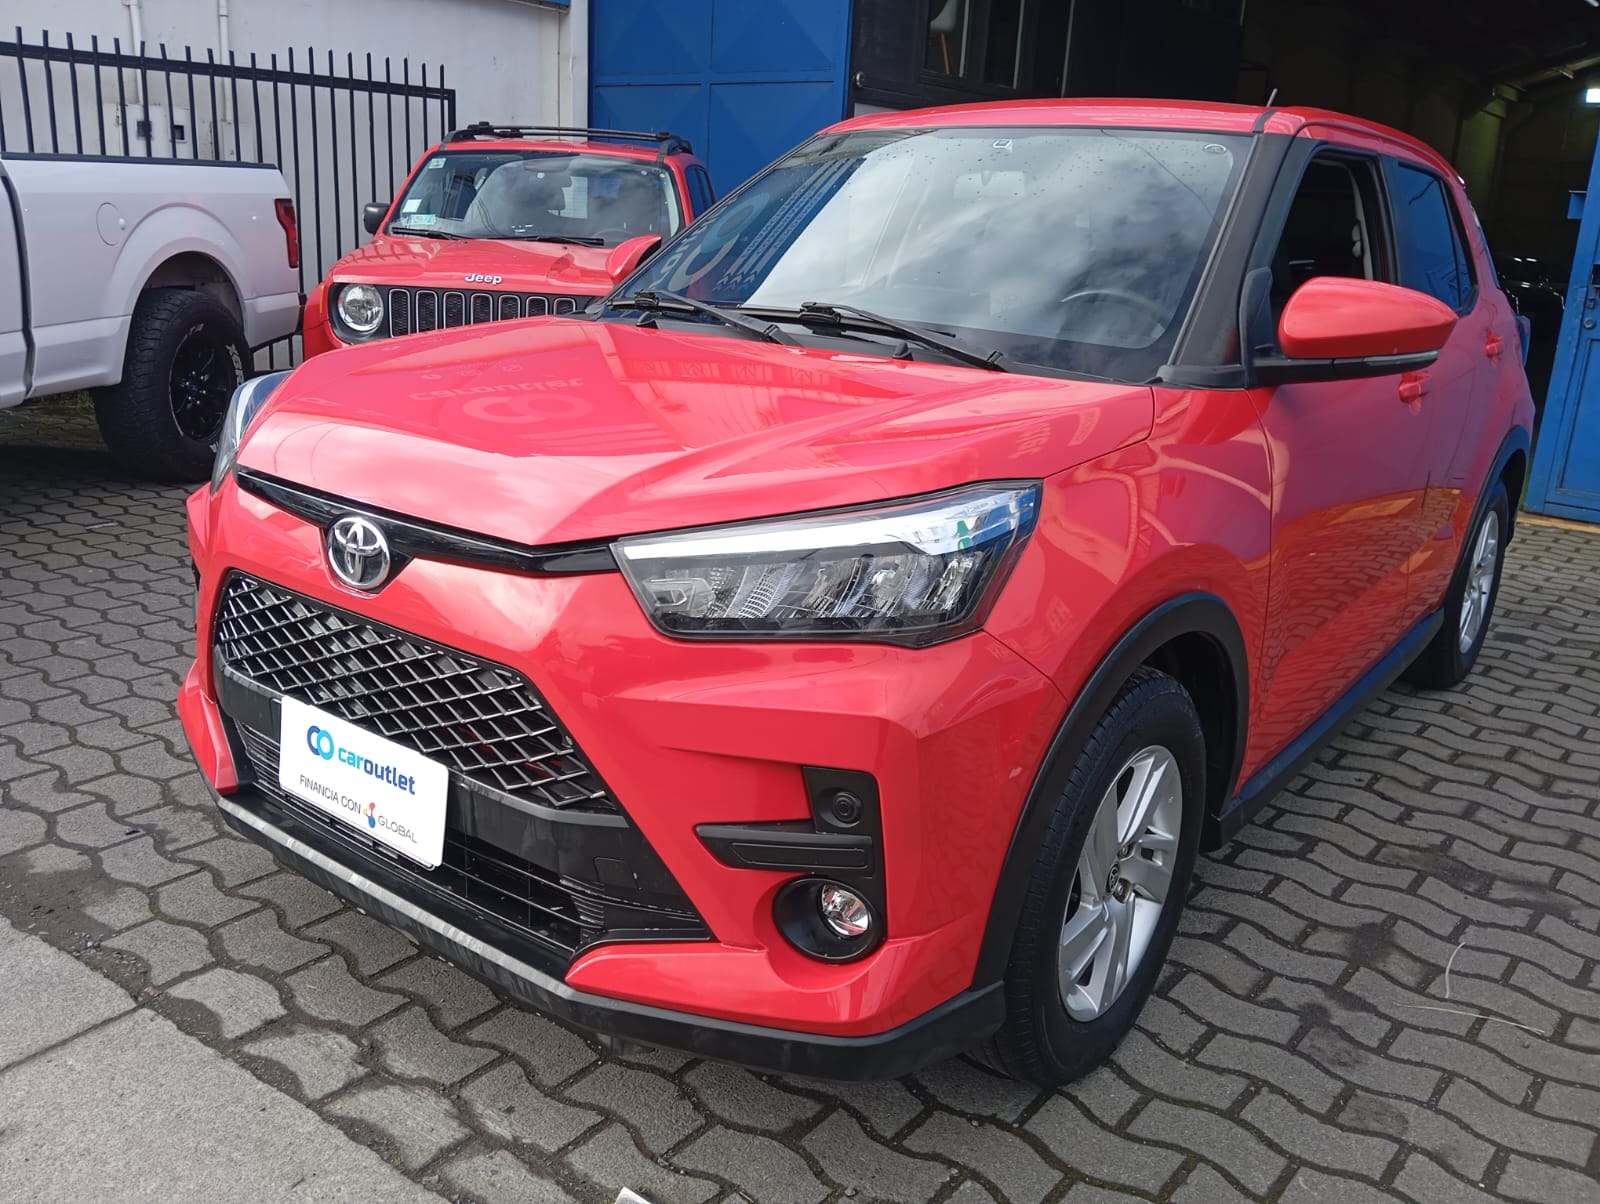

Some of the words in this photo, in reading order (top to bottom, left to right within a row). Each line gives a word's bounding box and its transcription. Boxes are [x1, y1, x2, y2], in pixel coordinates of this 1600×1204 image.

[464, 272, 503, 286] Jeep
[338, 747, 416, 795] caroutlet
[299, 774, 339, 804] FINANCIA
[340, 795, 362, 815] CON
[377, 815, 418, 844] GLOBAL
